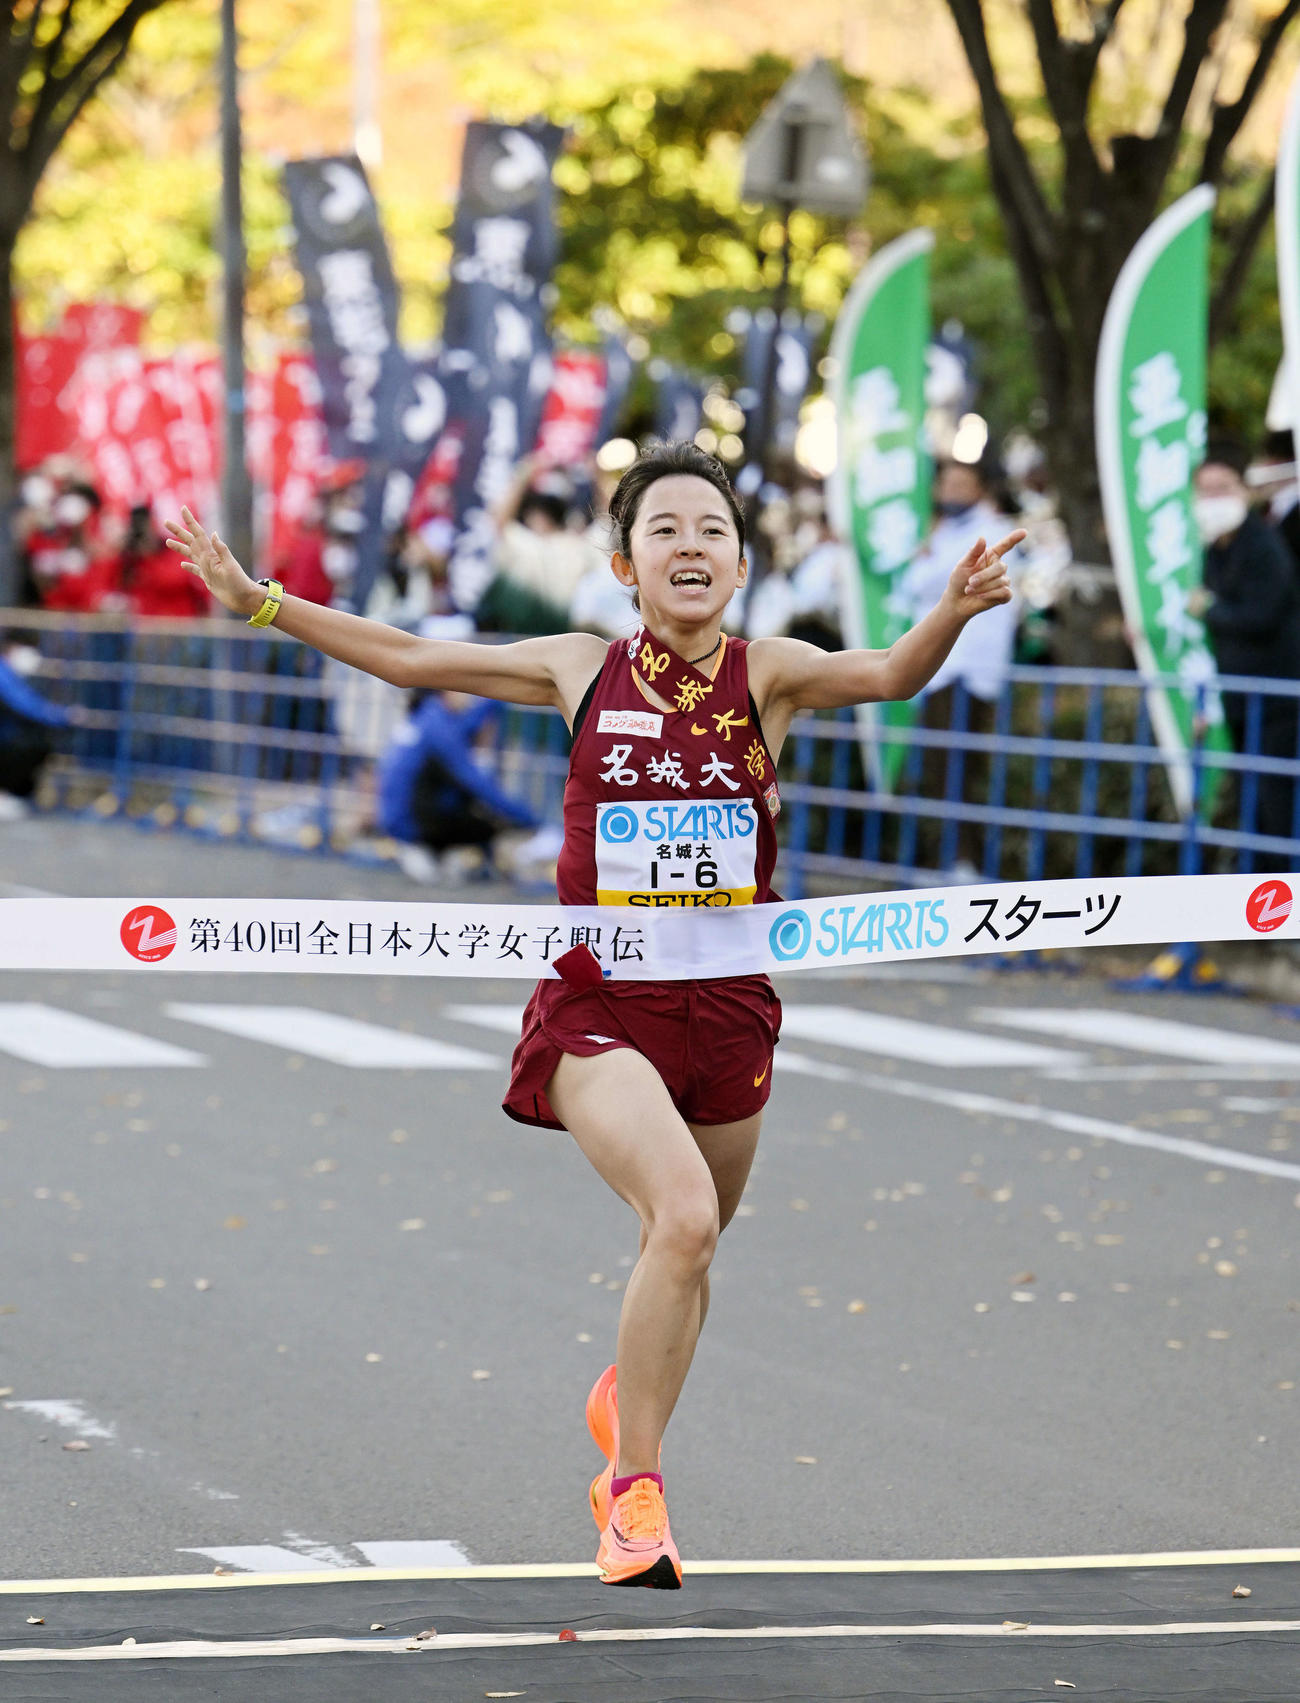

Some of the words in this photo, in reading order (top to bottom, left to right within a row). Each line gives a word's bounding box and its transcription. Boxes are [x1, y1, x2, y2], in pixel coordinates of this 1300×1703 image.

[599, 744, 742, 792] 名城大
[656, 843, 712, 860] 名城大
[651, 861, 718, 889] 1-6
[189, 917, 645, 963] 第40回全日本大学女子駅伝
[964, 894, 1122, 943] スターツ
